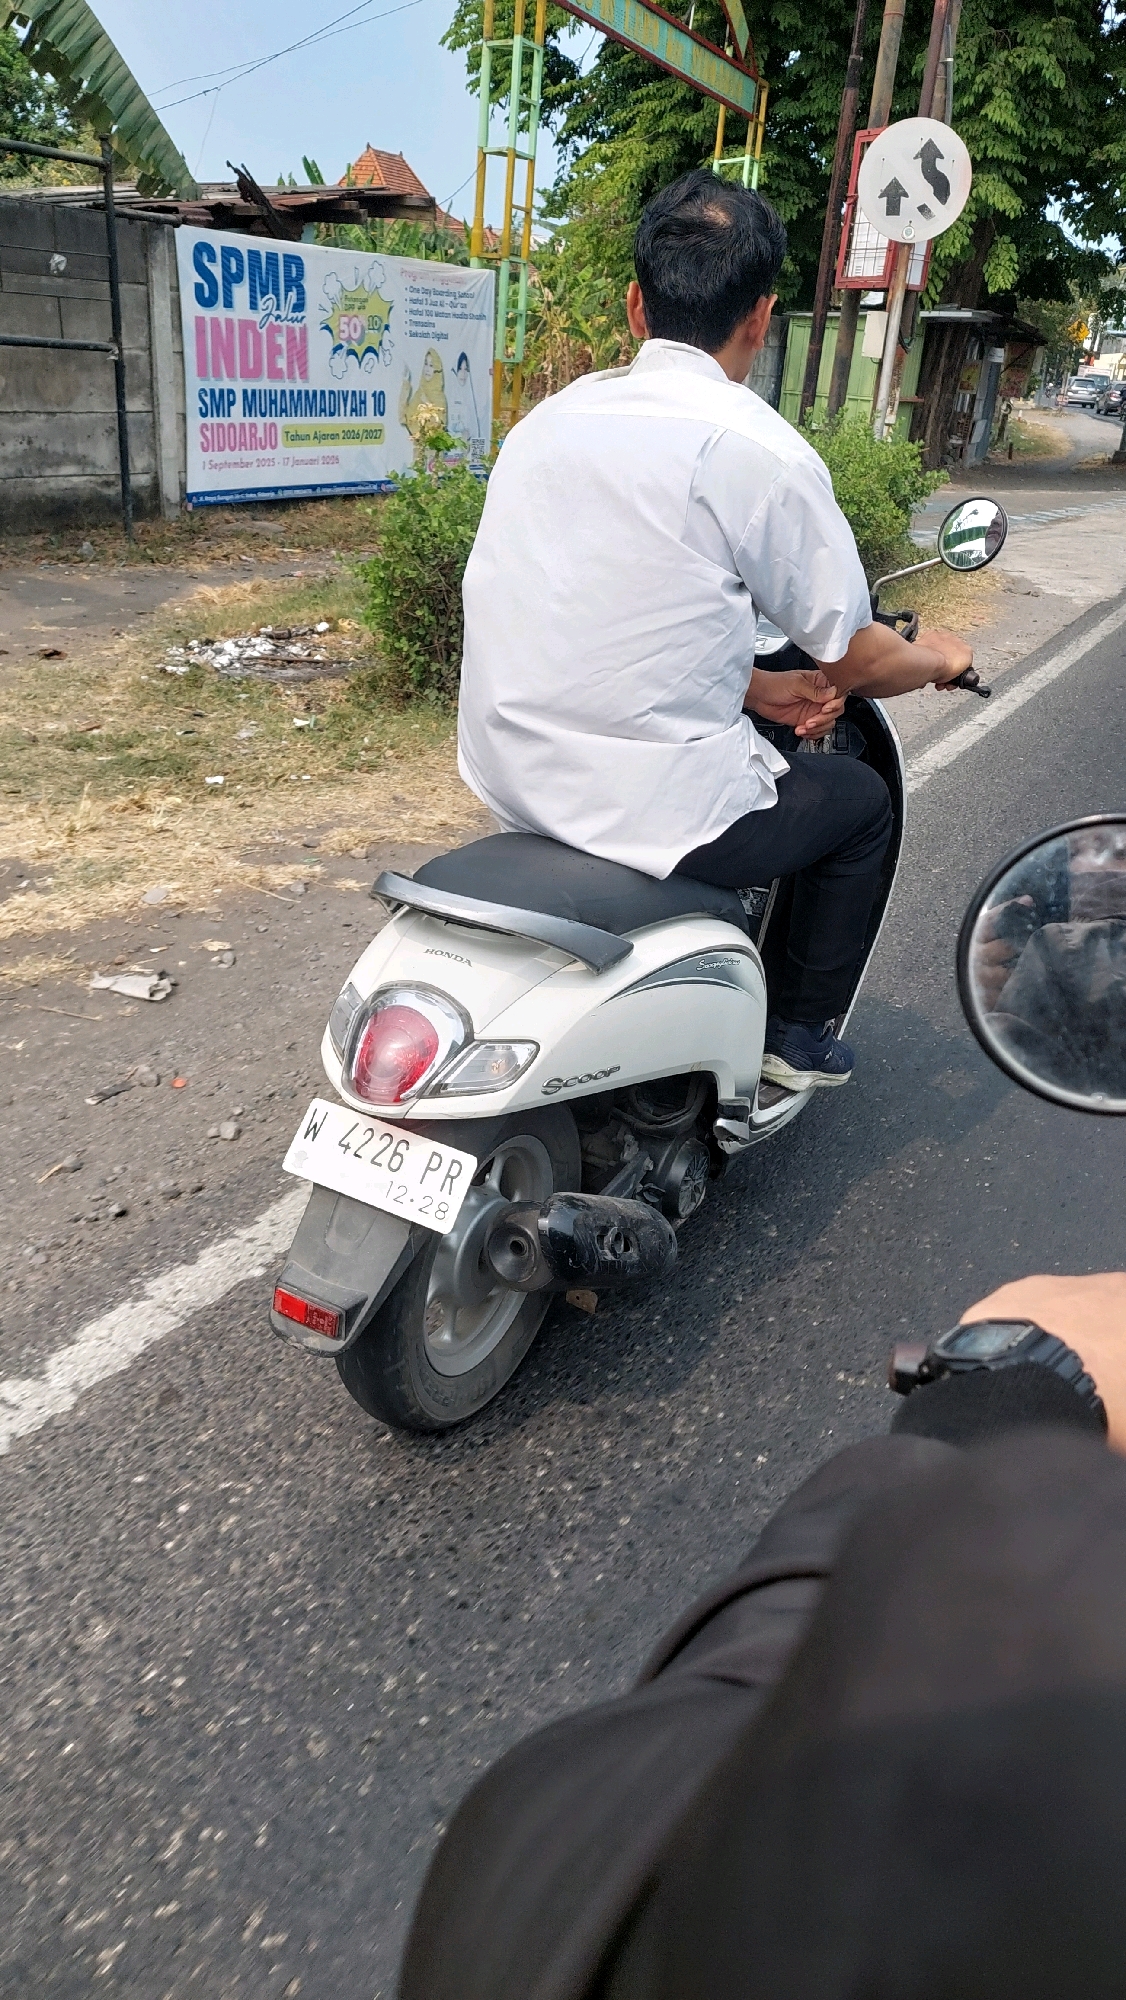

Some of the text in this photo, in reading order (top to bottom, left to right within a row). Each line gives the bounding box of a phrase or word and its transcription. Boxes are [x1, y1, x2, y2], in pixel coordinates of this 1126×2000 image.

[194, 315, 309, 381] INDEN
[198, 387, 386, 419] SMP MUHAMMADIYAH 10
[199, 421, 278, 453] SIDOARJO
[284, 428, 383, 444] Tahun Ajaran 2026/2027
[208, 457, 254, 472] September
[255, 456, 276, 468] 2025
[291, 455, 320, 468] Januari
[423, 948, 472, 968] HONDA
[303, 1108, 463, 1195] W 4226 PR
